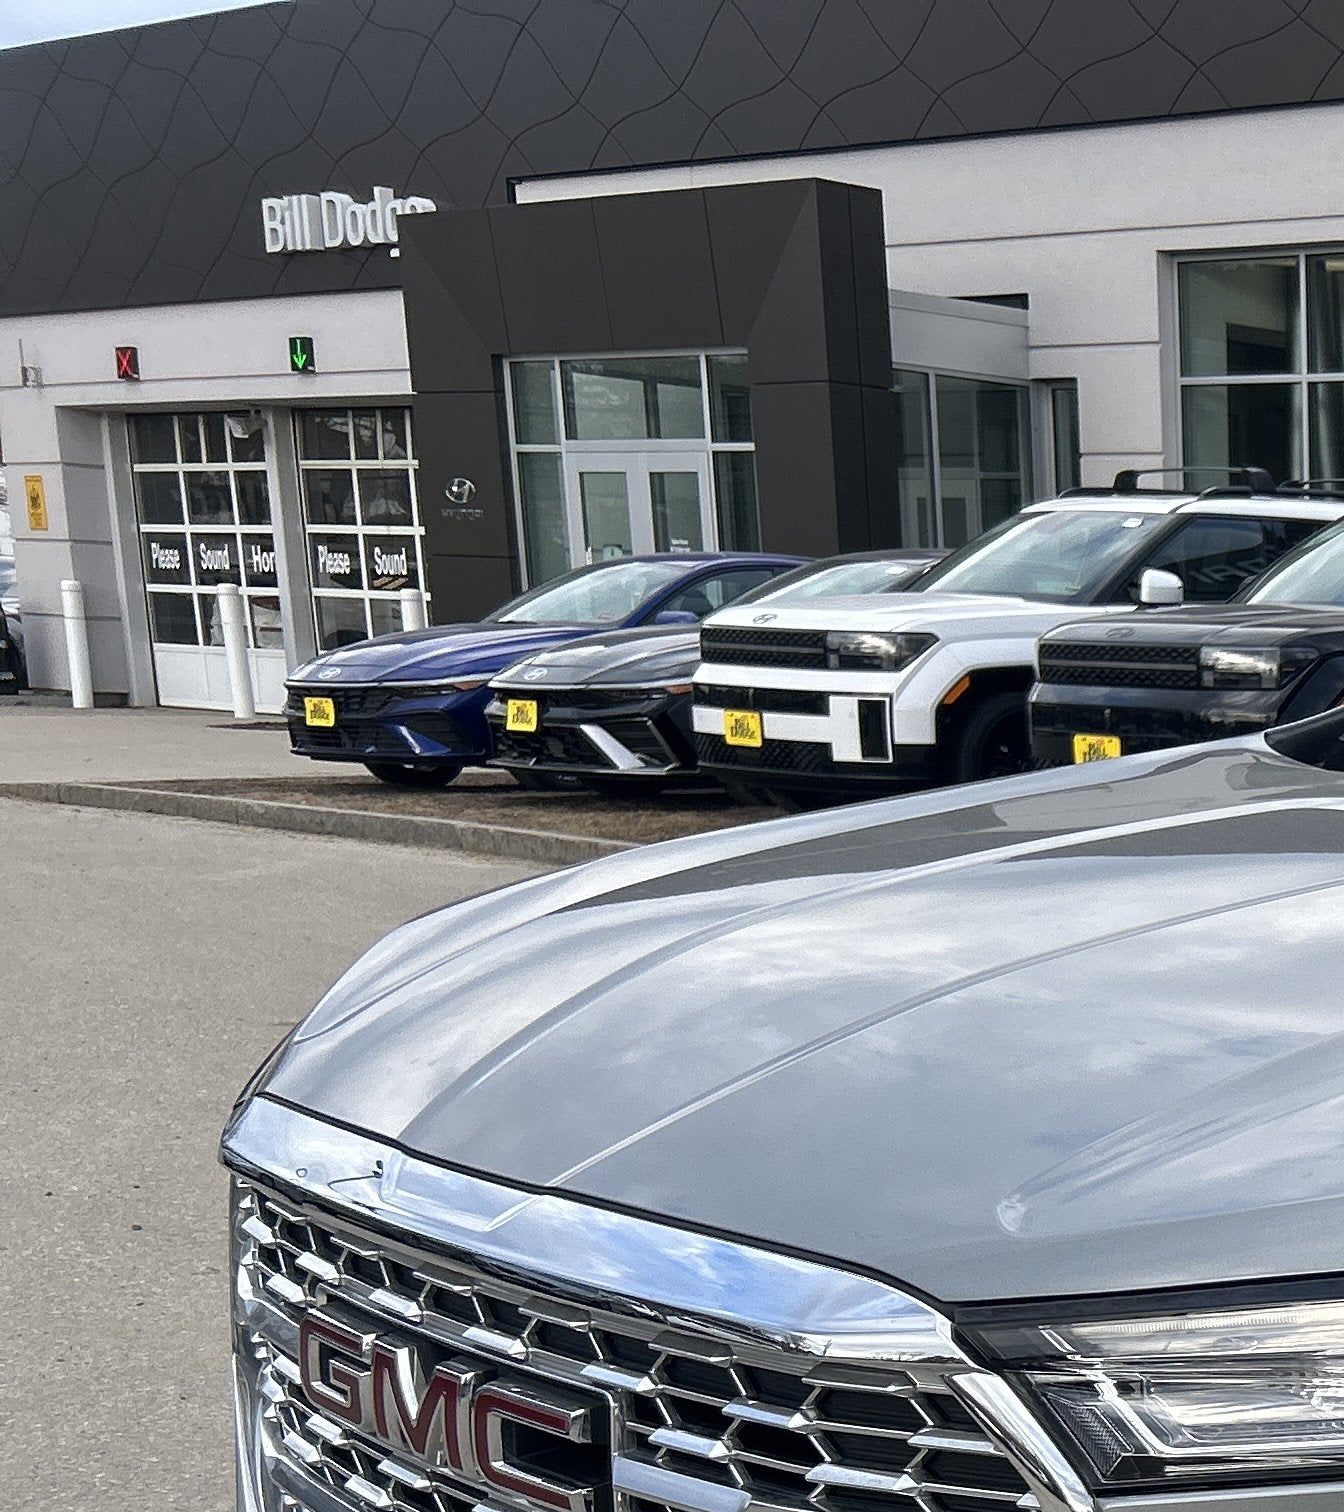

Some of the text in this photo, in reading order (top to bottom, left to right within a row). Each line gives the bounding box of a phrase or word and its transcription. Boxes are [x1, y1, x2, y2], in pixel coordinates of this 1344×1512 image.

[262, 194, 323, 253] Bill
[150, 542, 275, 573] Please Sound Hor
[318, 545, 408, 576] Please Sound
